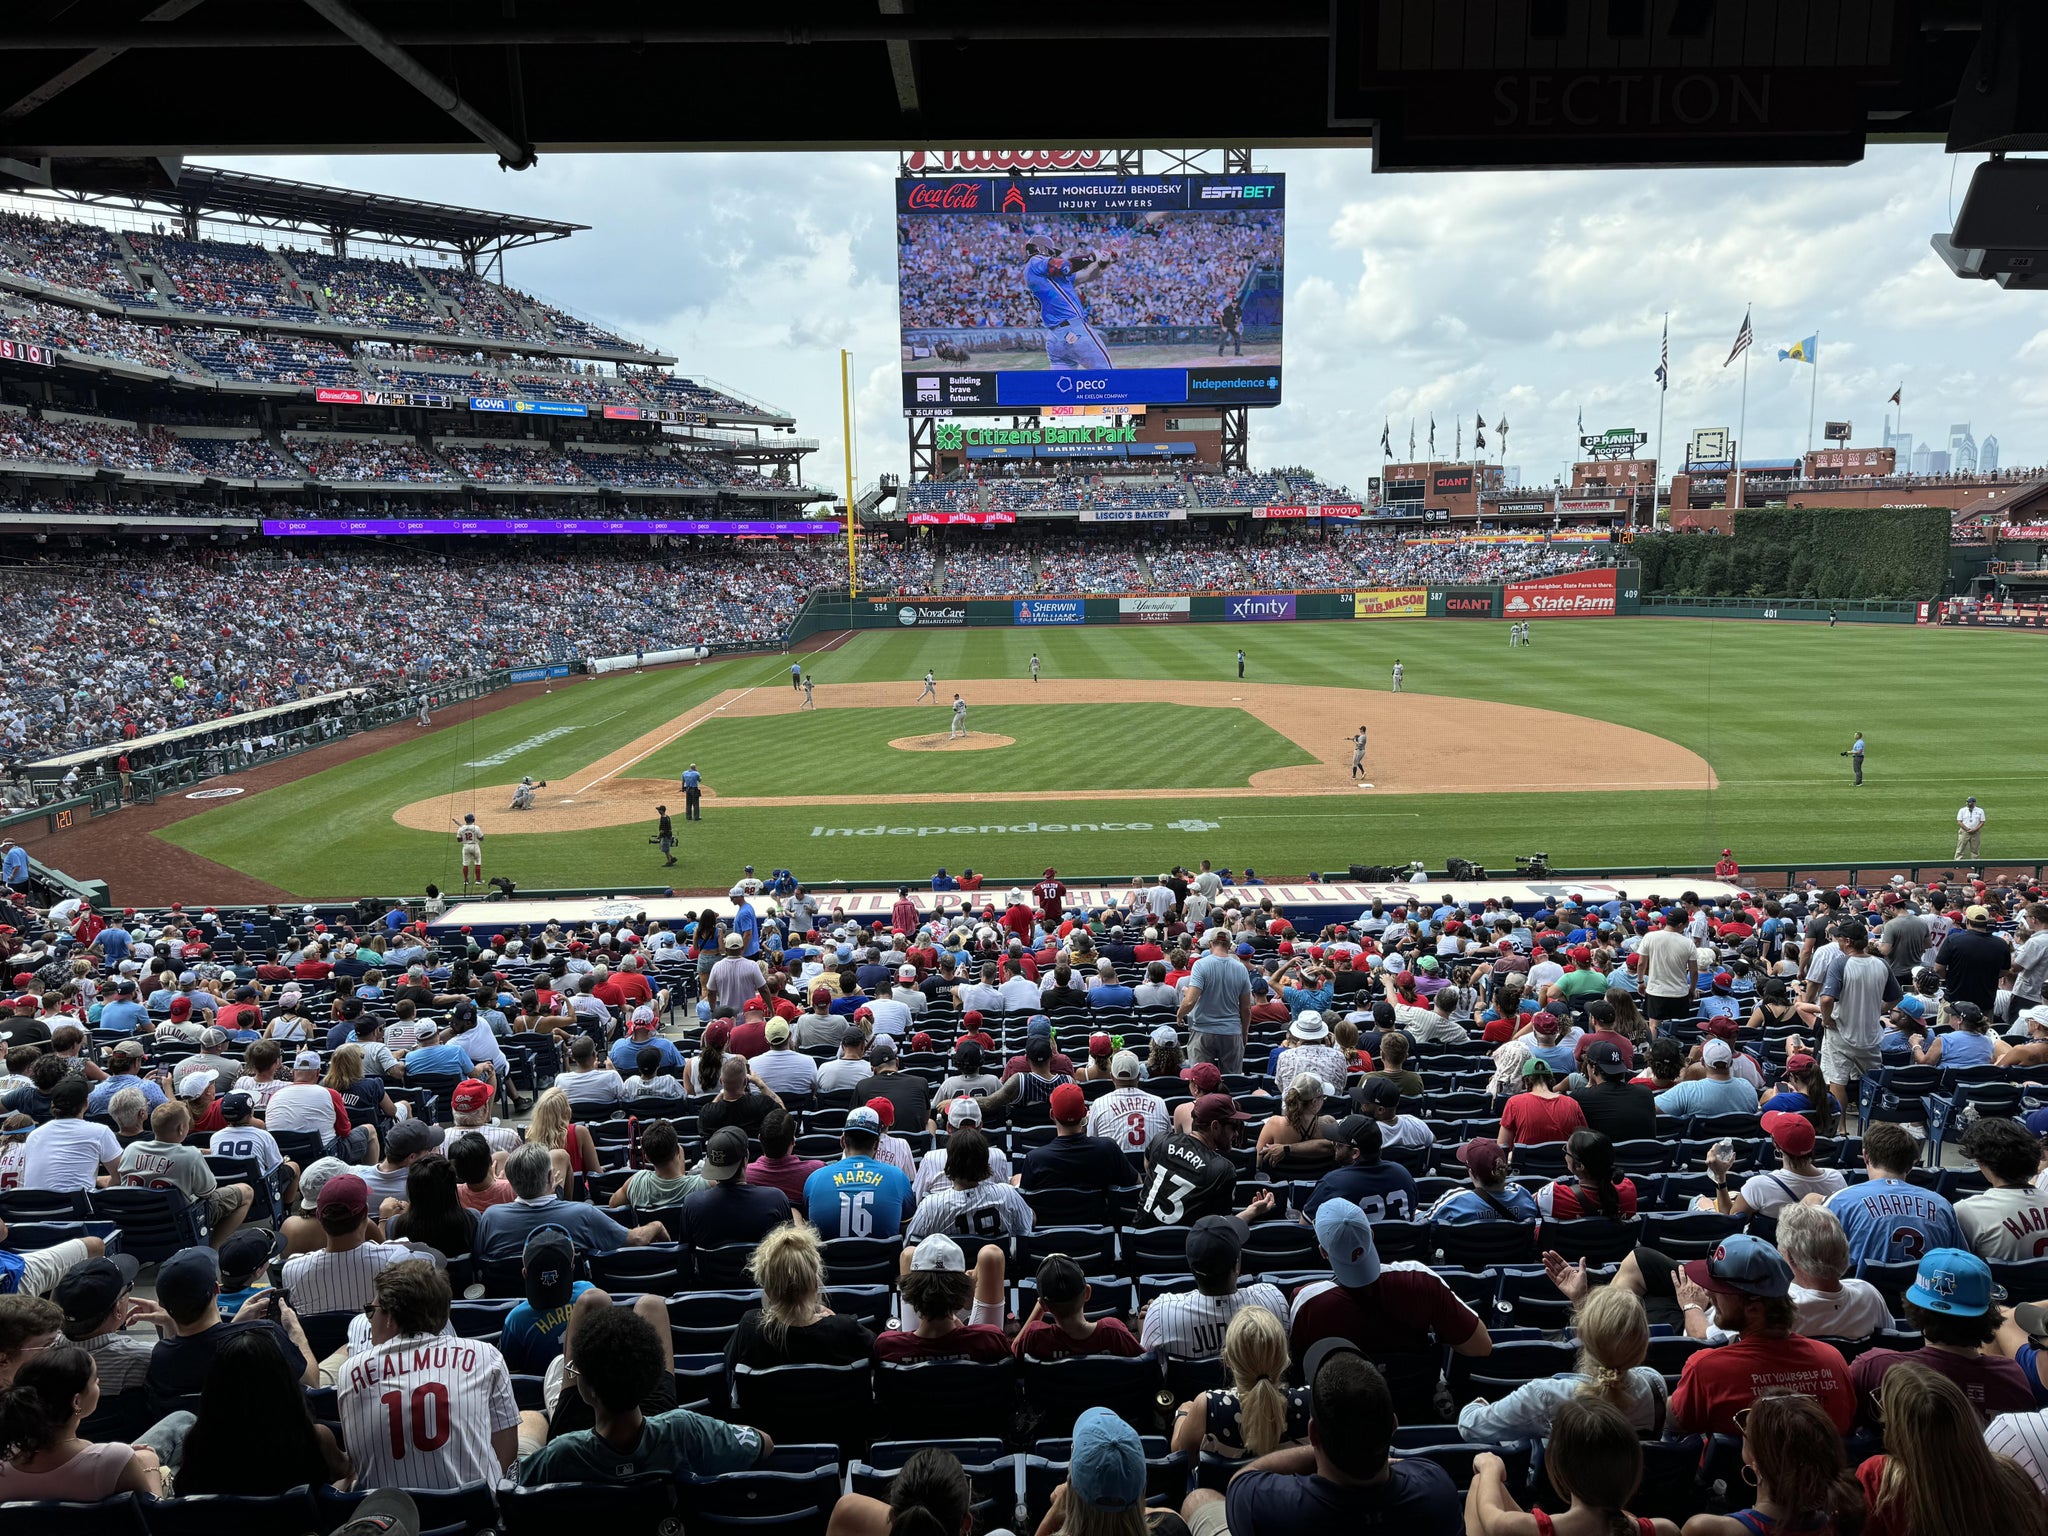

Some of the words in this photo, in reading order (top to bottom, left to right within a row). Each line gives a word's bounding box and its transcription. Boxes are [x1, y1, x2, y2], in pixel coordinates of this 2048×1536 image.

[1492, 73, 1771, 126] SECTION
[908, 183, 982, 209] Coca-Cola
[1029, 186, 1058, 196] SALTZ
[1062, 186, 1126, 195] MONGELUZZI
[1131, 185, 1182, 194] BENDESKY
[1059, 200, 1097, 208] INJURY
[1105, 200, 1152, 208] LAWYERS
[949, 377, 981, 386] Building
[1076, 379, 1106, 392] peco
[1193, 378, 1265, 390] Independence
[476, 399, 504, 409] GOYA
[966, 427, 1041, 445] Citizens
[1044, 426, 1092, 444] Bank
[1095, 424, 1136, 443] Park
[1437, 478, 1468, 486] GIANT
[911, 514, 922, 524] JIM
[922, 513, 939, 524] BEAM
[947, 513, 959, 524] JIM
[959, 513, 976, 524] BEAM
[984, 513, 995, 524] JIM
[996, 512, 1012, 523] BEAM
[1095, 512, 1132, 520] LISCIO'S
[1340, 594, 1353, 603] 374
[1431, 593, 1442, 601] 387
[1624, 590, 1638, 598] 409
[1033, 602, 1076, 612] SHERWIN
[1132, 600, 1177, 611] Yuengling
[1233, 598, 1288, 618] xfinity
[1446, 599, 1491, 610] GIANT
[918, 607, 965, 618] NovaCare
[1764, 609, 1777, 618] 401
[511, 670, 544, 680] dependence
[812, 822, 1154, 837] Independence
[1043, 889, 1056, 899] 10
[1222, 886, 1418, 903] HILLIES
[1110, 1097, 1156, 1116] HARPER
[1127, 1113, 1146, 1146] 3
[877, 1149, 895, 1162] RPER
[1168, 1144, 1206, 1170] BARRY
[136, 1154, 174, 1175] UTLEY
[833, 1170, 883, 1188] MARSH
[1143, 1164, 1197, 1225] 13
[839, 1191, 874, 1237] 16
[1863, 1194, 1936, 1222] HARPER
[1891, 1226, 1924, 1260] 3
[350, 1346, 476, 1394] REALMUTO
[1751, 1373, 1773, 1384] PUT
[1773, 1371, 1819, 1382] YOURSELF
[1821, 1369, 1832, 1379] ON
[381, 1382, 449, 1460] 10
